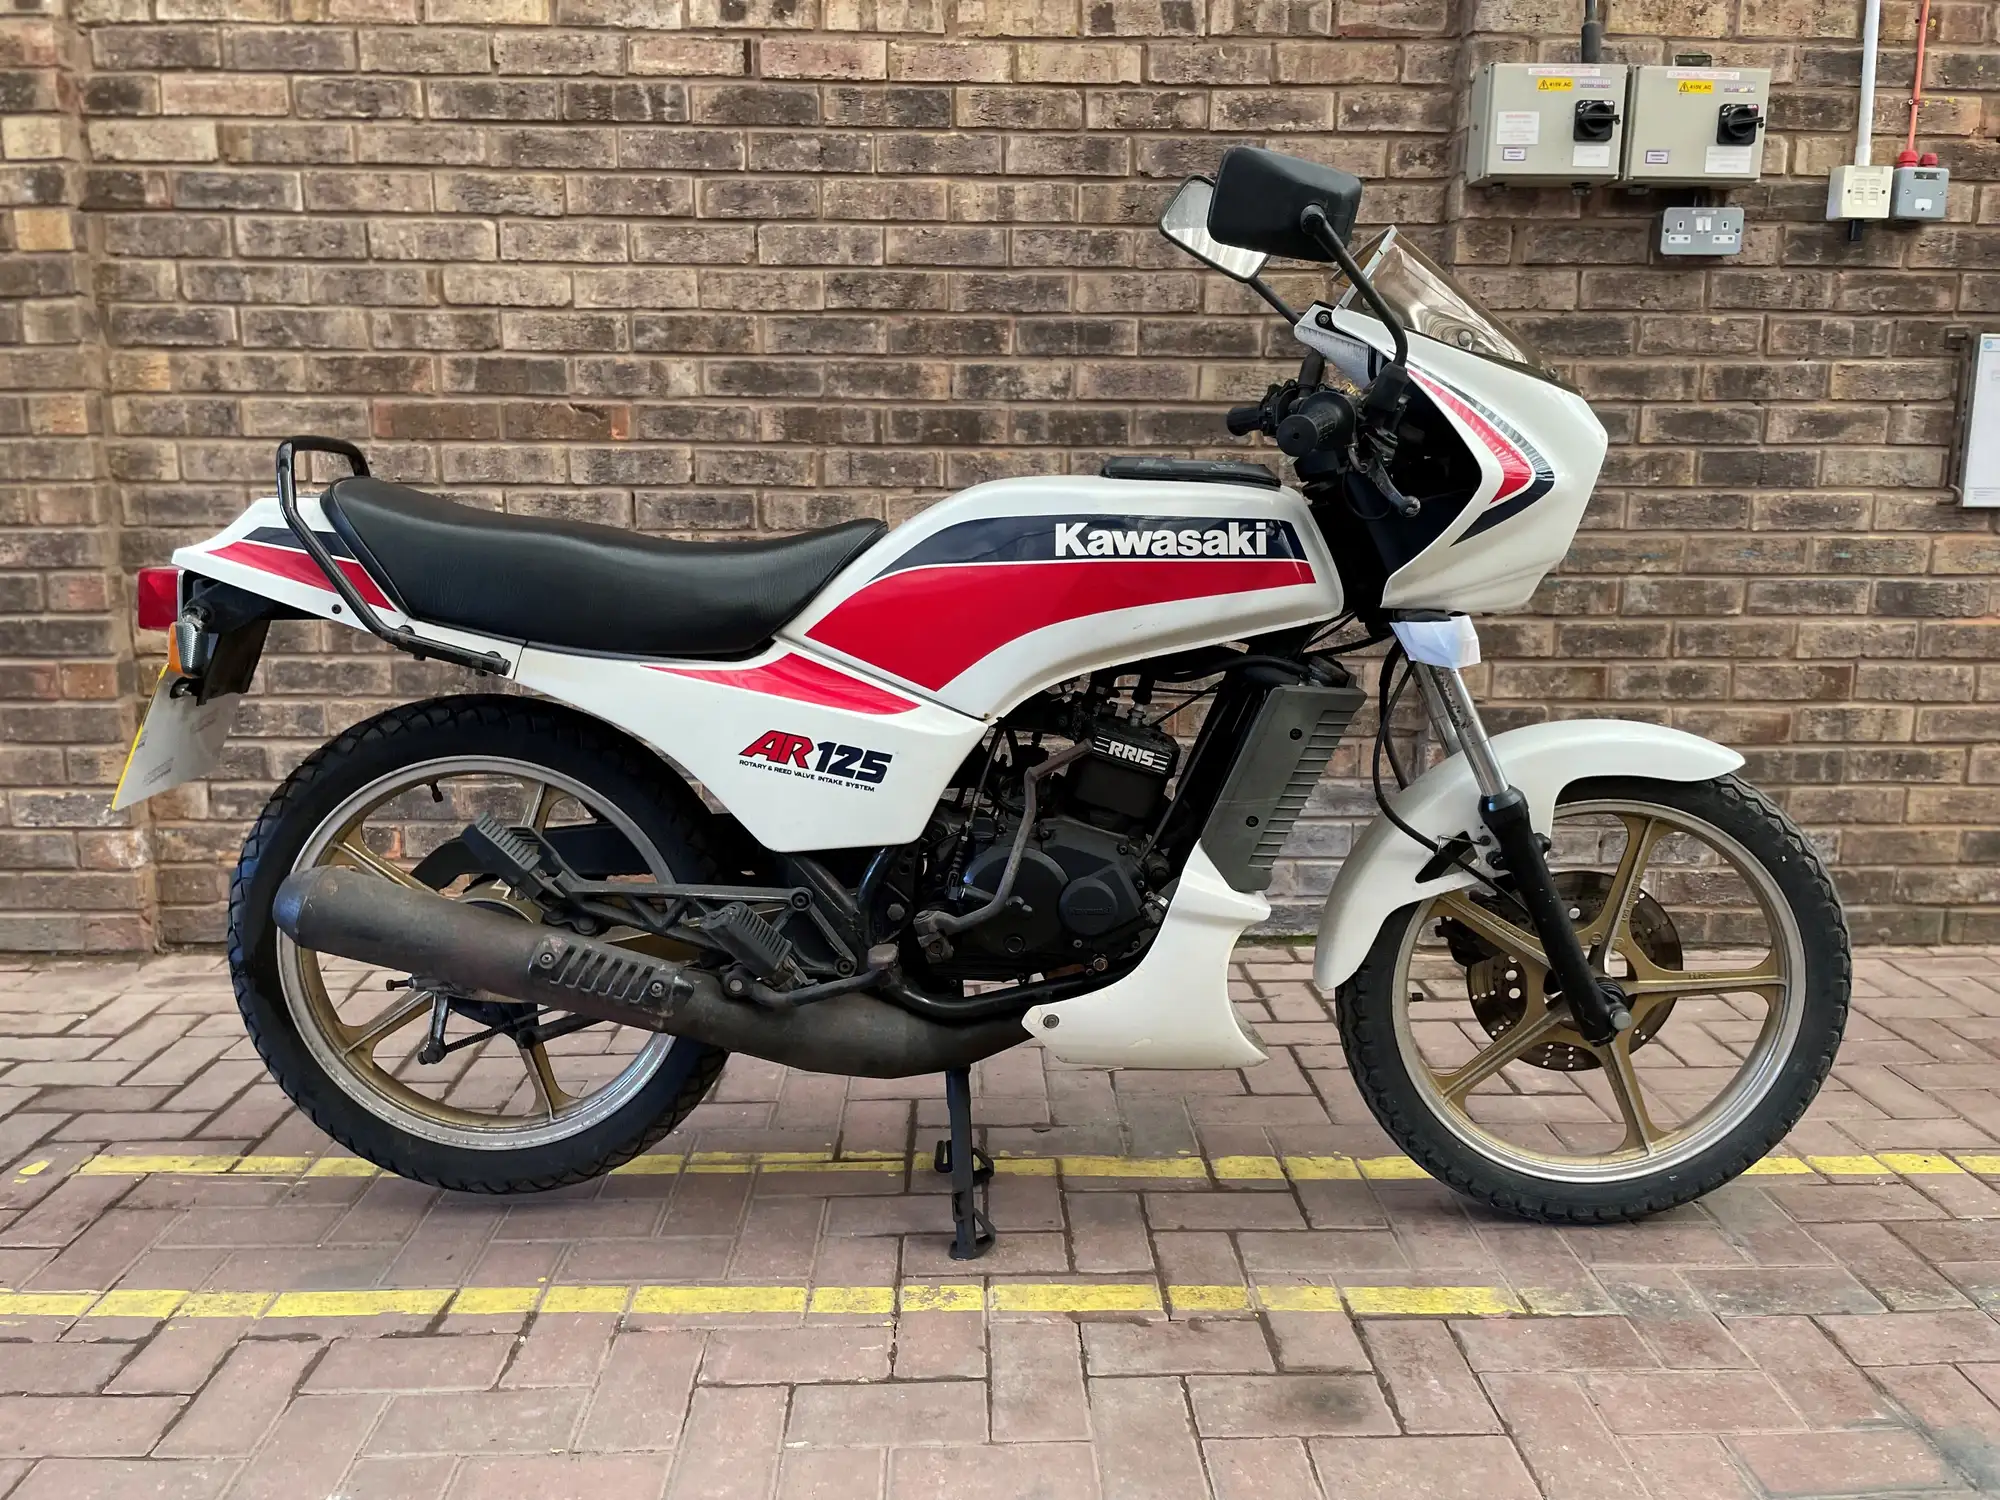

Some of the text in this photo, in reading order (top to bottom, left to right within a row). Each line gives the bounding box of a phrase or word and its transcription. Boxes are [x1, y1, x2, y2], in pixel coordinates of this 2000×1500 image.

[1055, 521, 1267, 557] Kawasaki
[1108, 742, 1156, 766] RRIS
[739, 759, 766, 769] ROTARY
[774, 766, 792, 775] REED
[793, 770, 815, 780] VALVE
[817, 775, 843, 786] INTAKE
[845, 781, 875, 792] SYSTEM
